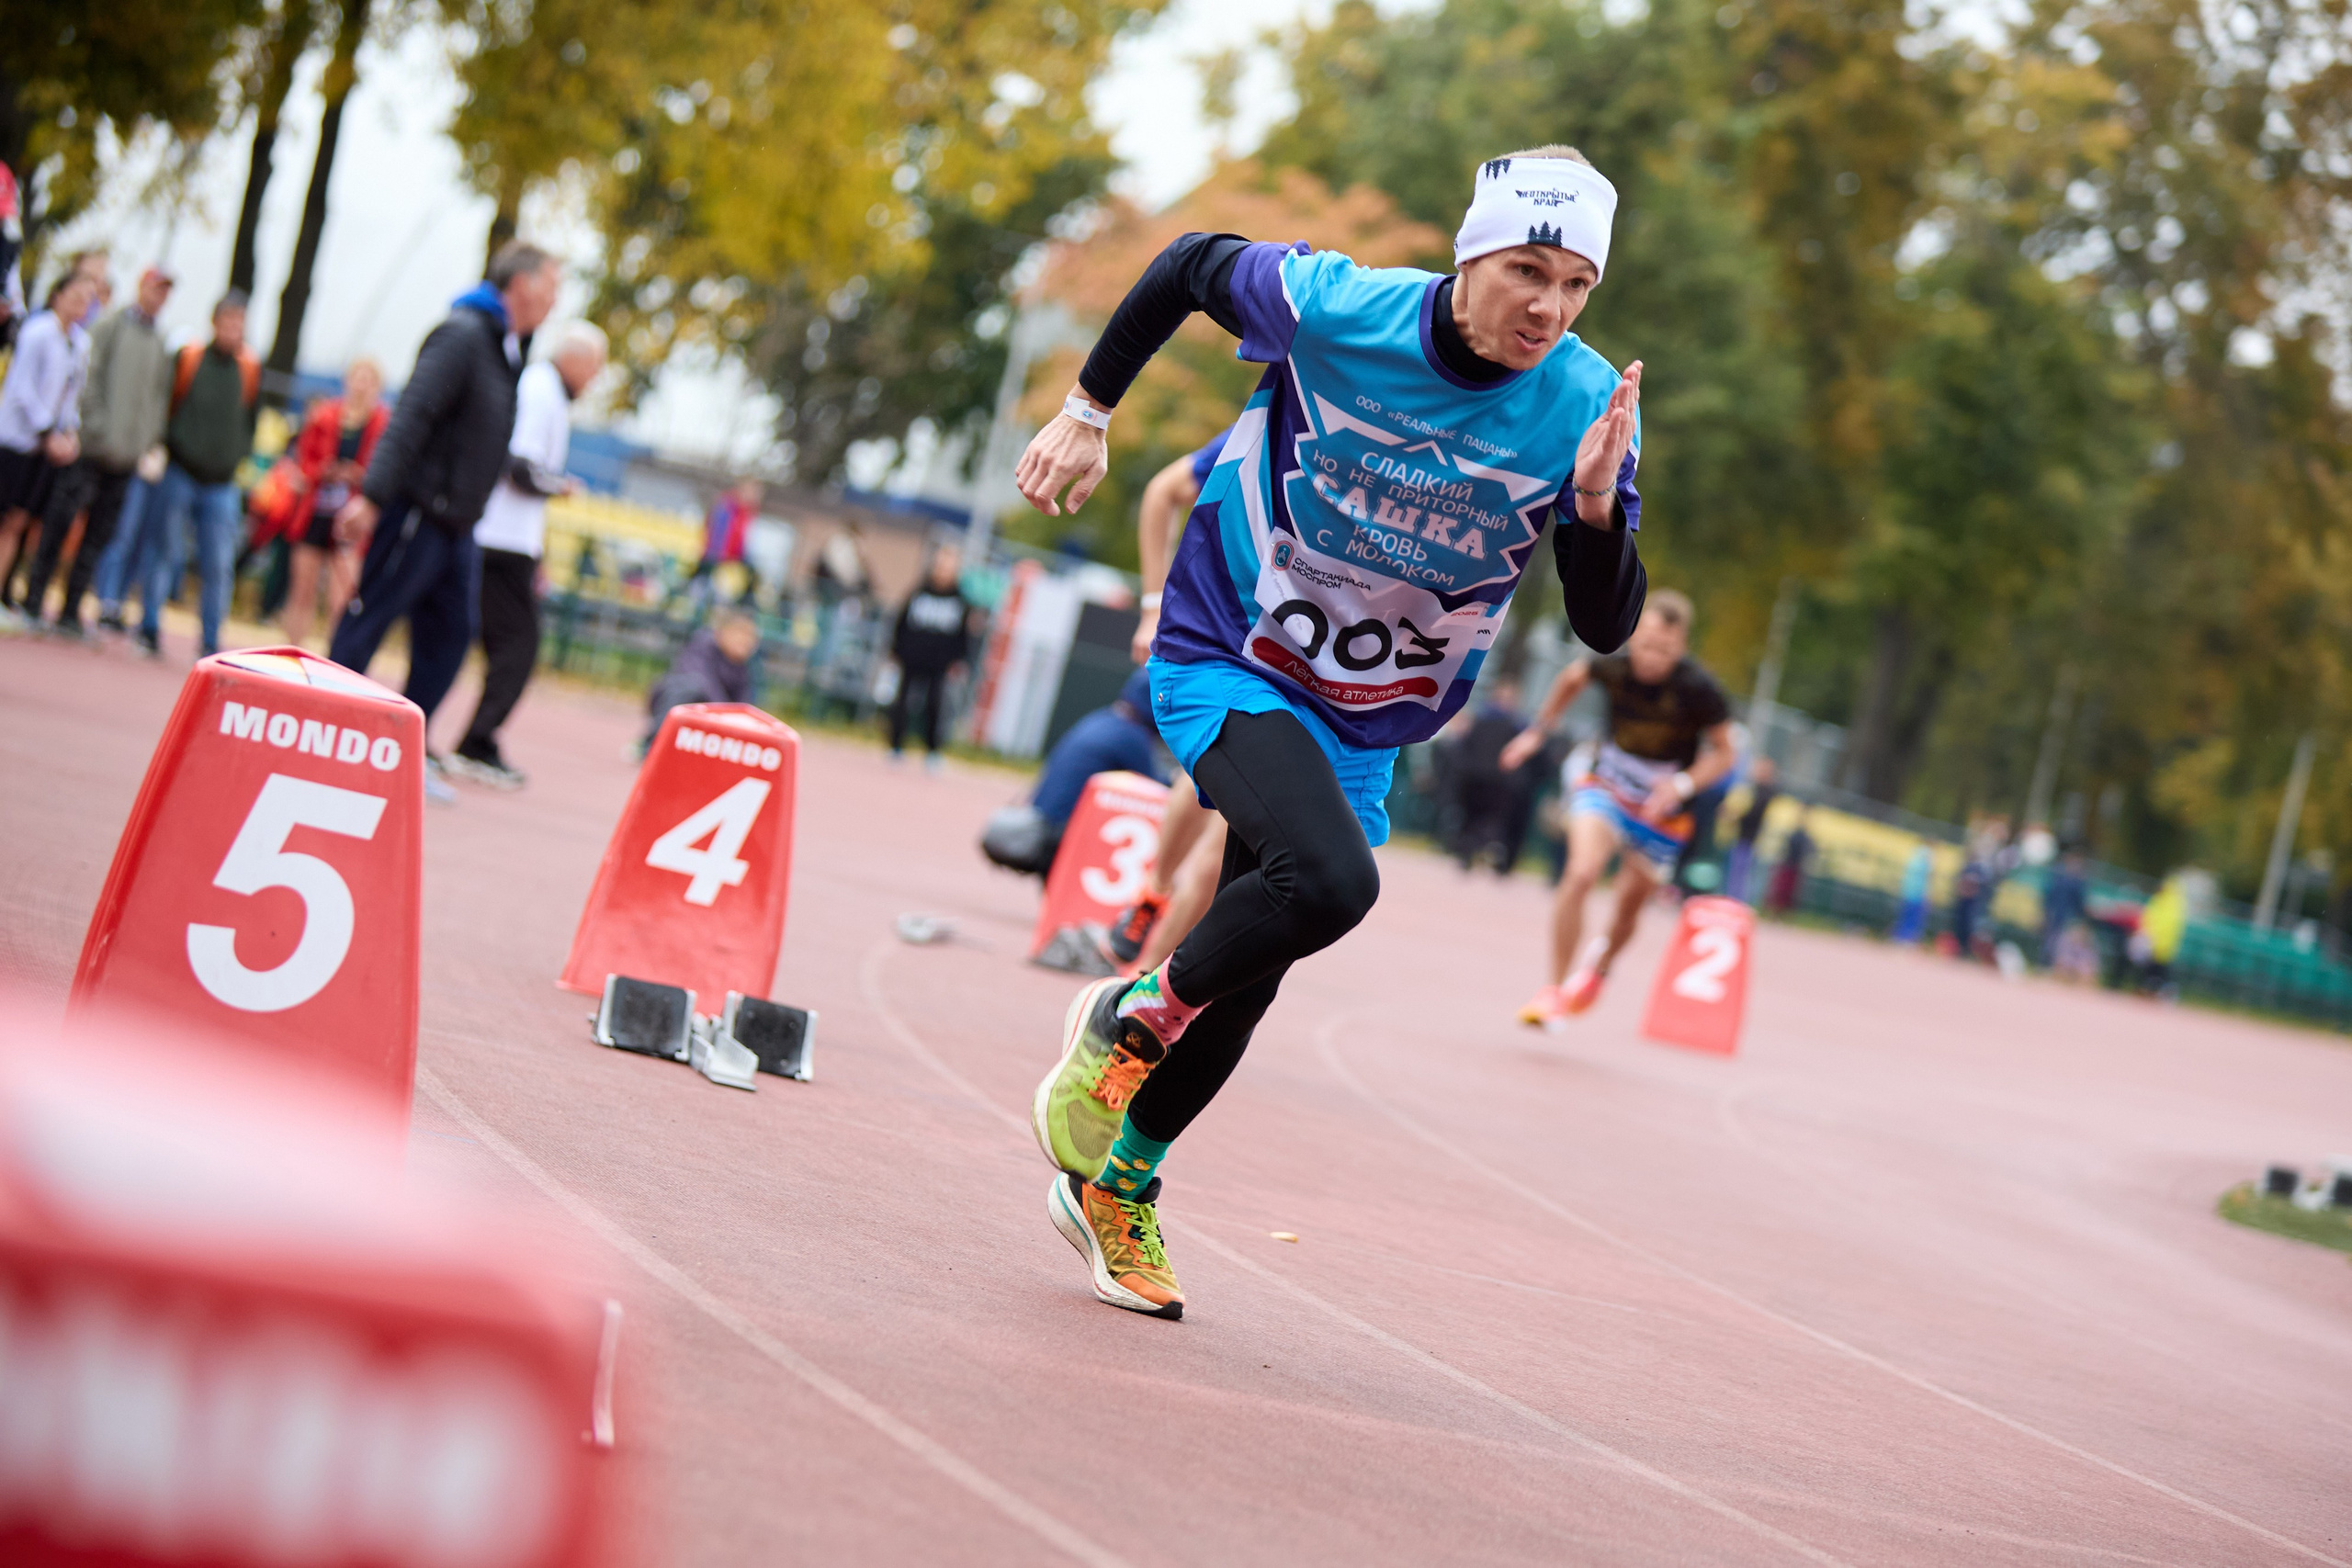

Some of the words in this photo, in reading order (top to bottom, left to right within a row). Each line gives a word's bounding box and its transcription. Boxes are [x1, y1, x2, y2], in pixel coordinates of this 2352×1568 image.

[1355, 395, 1381, 413] ООО
[1387, 412, 1457, 440] «РЕАЛЬНЫЕ
[1463, 434, 1518, 458] ПАЦАНЫ»
[1314, 449, 1338, 472] НО
[1349, 469, 1374, 488] НЕ
[1388, 485, 1509, 532] ПРИТОРНЫЙ
[1361, 451, 1474, 502] СЛАДКИЙ
[1311, 471, 1488, 560] САШКА
[1353, 524, 1428, 562] КРОВЬ
[1291, 564, 1342, 590] МОСПРОМ
[1295, 557, 1372, 591] СПАРТАКИАДА
[1317, 528, 1333, 547] С
[1345, 538, 1455, 586] МОЛОКОМ
[1284, 660, 1340, 697] Лёгкая
[1342, 685, 1404, 701] атлетика
[220, 701, 402, 772] MONDO
[674, 726, 783, 772] MONDO
[645, 776, 772, 908] 4
[1080, 814, 1159, 906] 3
[187, 773, 388, 1011] 5
[1672, 928, 1741, 1004] 2
